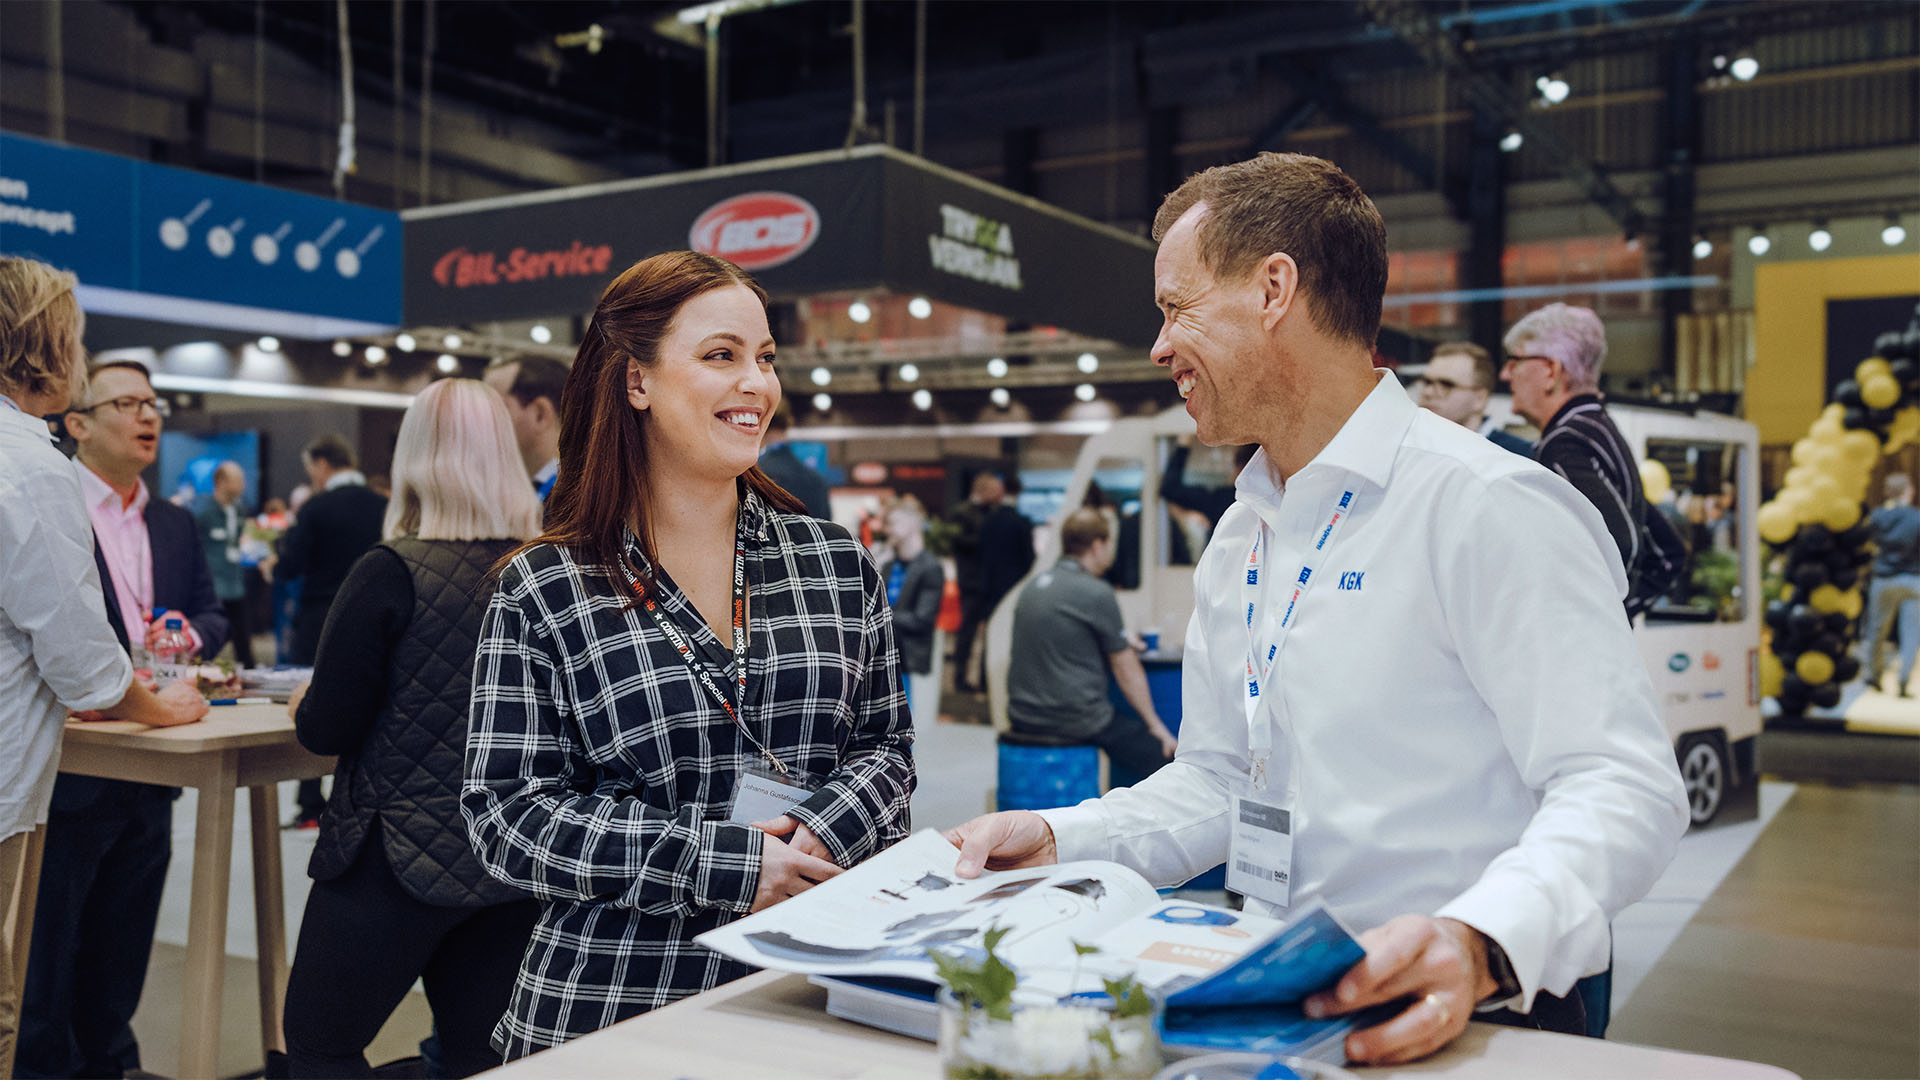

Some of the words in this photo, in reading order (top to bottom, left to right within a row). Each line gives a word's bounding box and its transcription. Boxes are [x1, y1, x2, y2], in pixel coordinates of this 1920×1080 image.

[1338, 490, 1353, 509] KGK
[1247, 569, 1257, 585] KGK
[1298, 567, 1312, 585] KGK
[1338, 571, 1364, 590] KGK
[734, 599, 745, 655] SpecialWheels
[660, 620, 696, 664] CONTINOVA
[1248, 680, 1259, 697] KGK
[743, 783, 769, 795] Johanna
